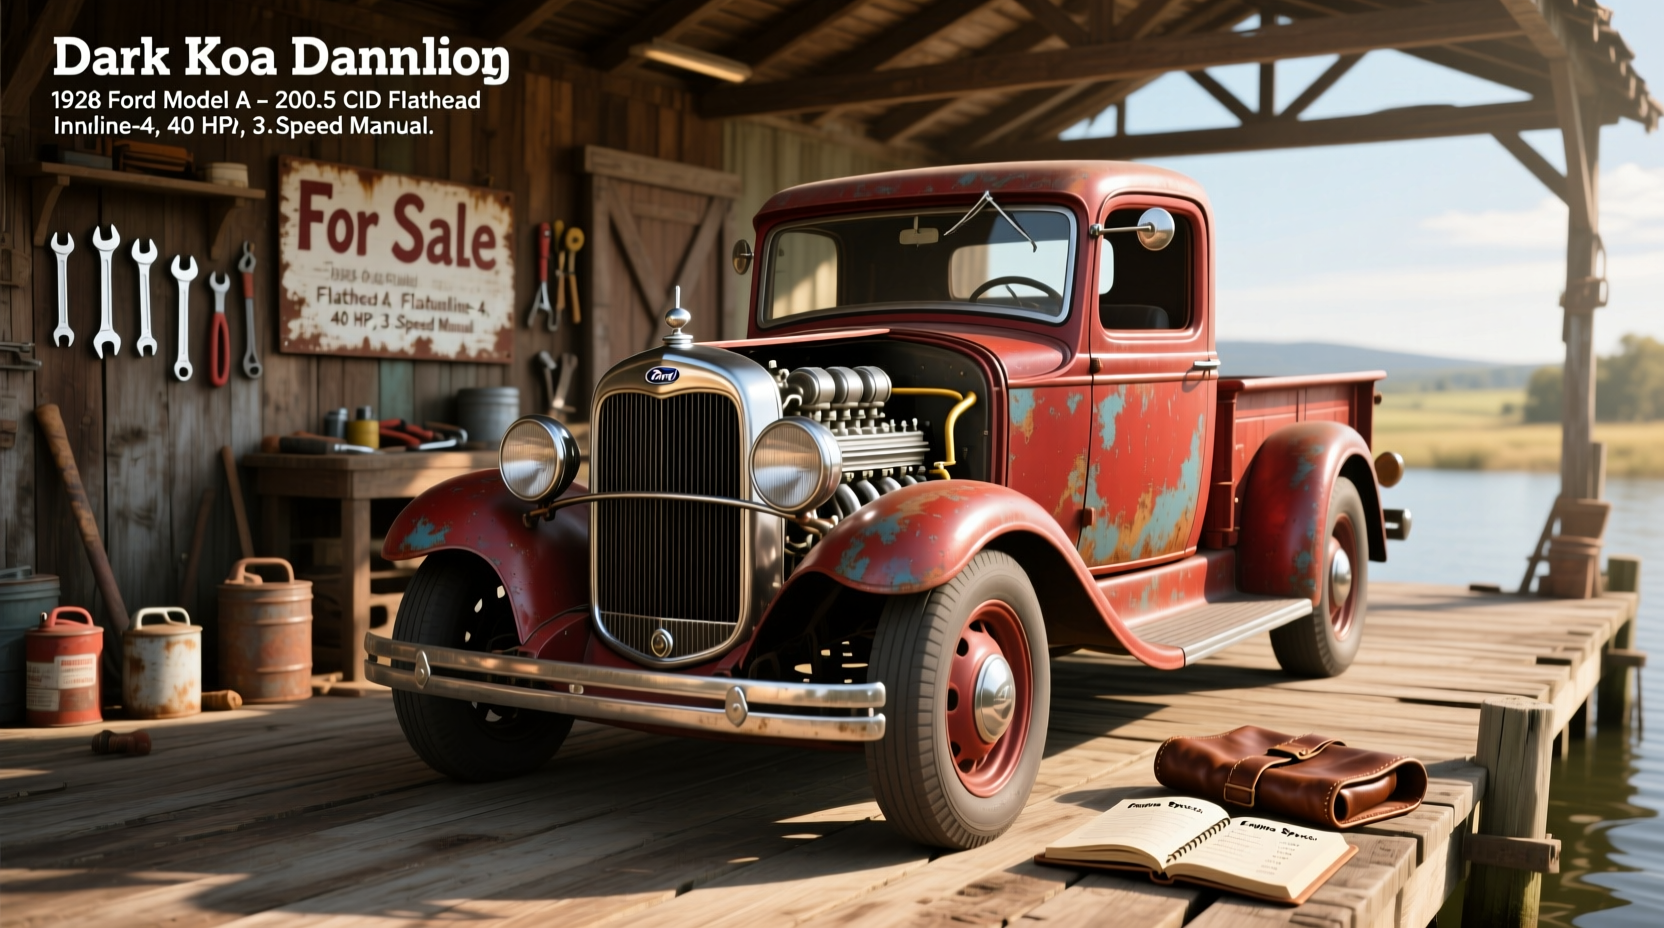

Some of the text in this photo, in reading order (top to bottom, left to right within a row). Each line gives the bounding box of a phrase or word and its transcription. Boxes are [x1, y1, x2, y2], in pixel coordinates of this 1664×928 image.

[298, 179, 496, 271] For Sale
[330, 311, 349, 326] 40
[380, 313, 390, 329] 3
